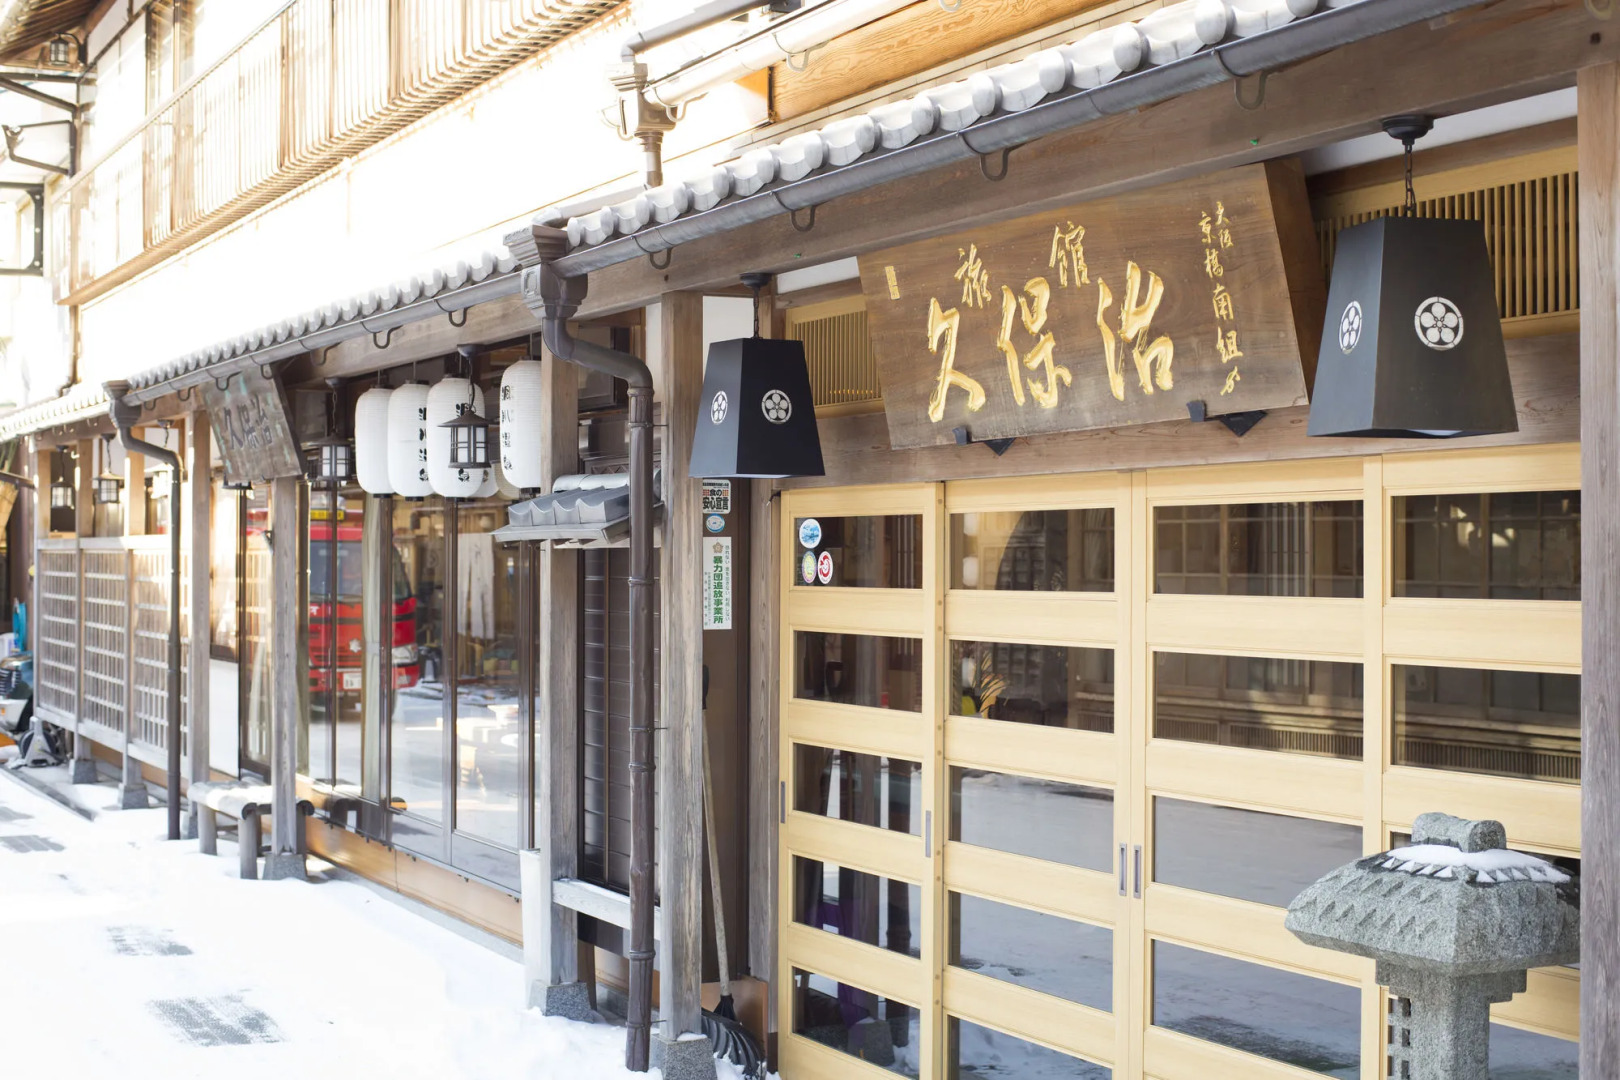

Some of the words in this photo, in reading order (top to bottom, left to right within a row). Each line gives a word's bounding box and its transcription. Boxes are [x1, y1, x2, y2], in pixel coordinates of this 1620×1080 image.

[954, 221, 1090, 309] 旅館
[927, 260, 1174, 423] 久保治
[703, 497, 729, 510] 安心宣言
[709, 489, 722, 497] 食の
[713, 556, 723, 624] 暴力団追放事業所
